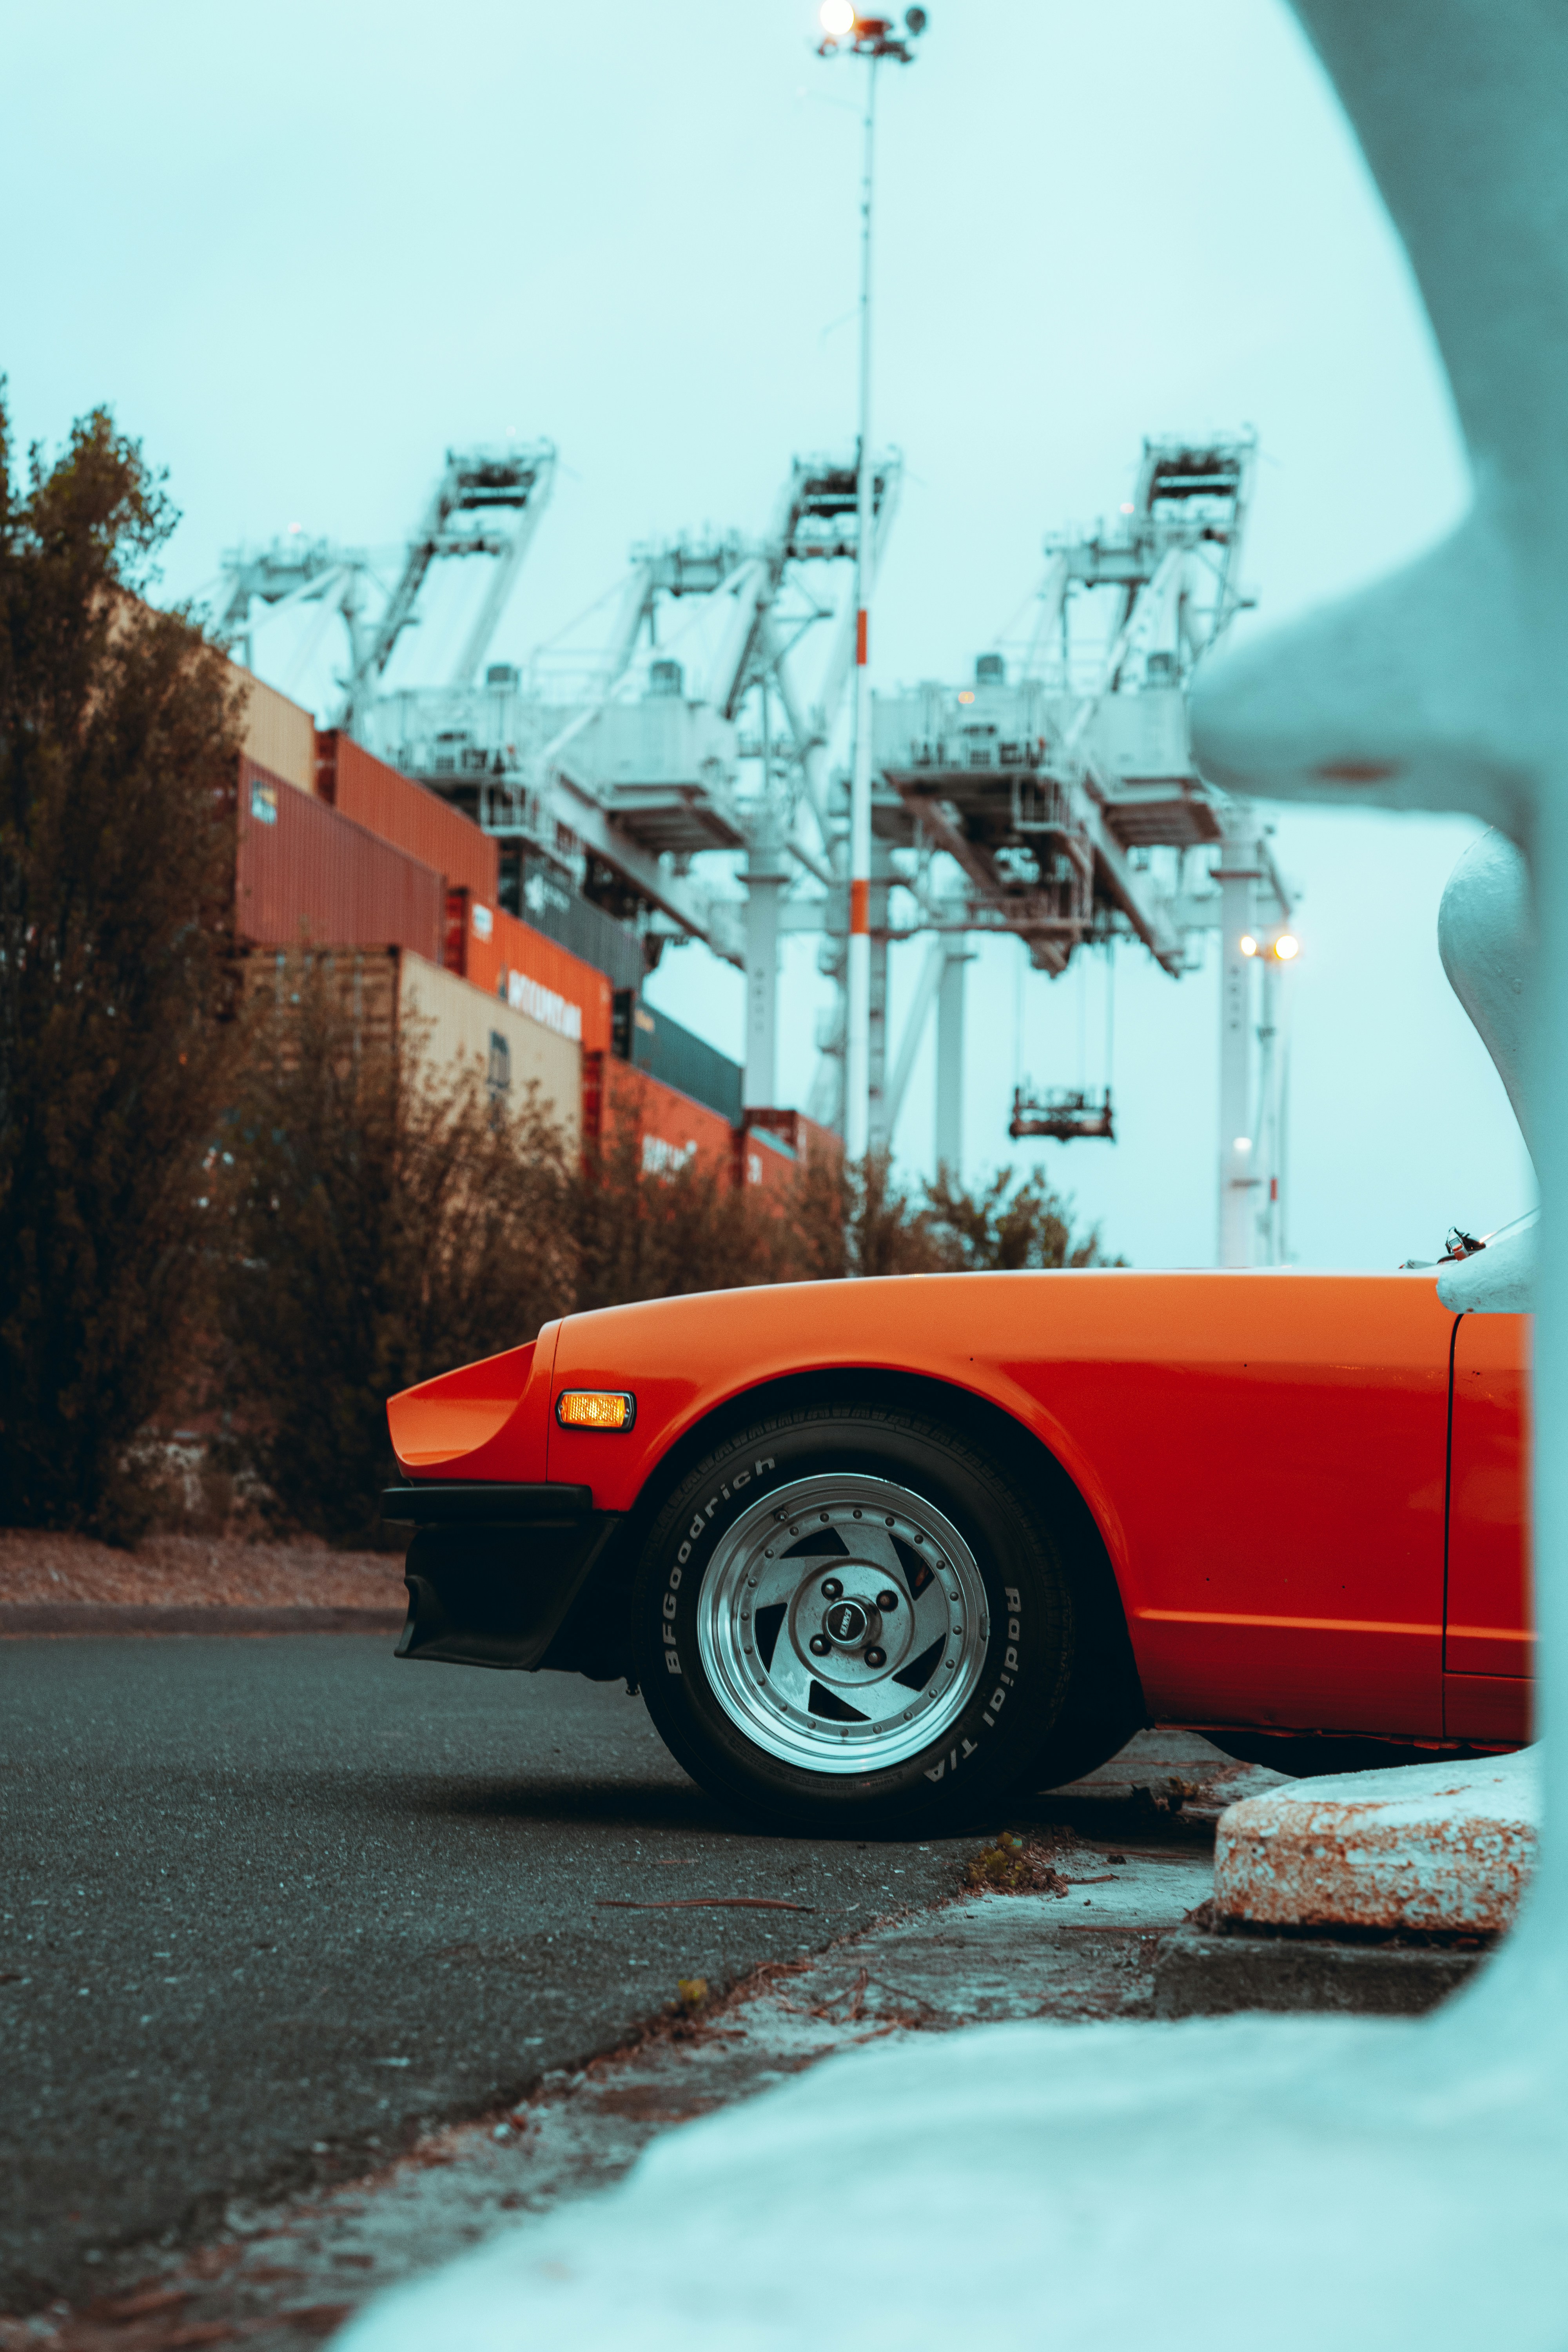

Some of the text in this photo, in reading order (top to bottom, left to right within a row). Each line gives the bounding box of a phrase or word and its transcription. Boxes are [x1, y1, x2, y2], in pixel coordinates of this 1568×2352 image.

[663, 1457, 775, 1673] BFGoodrich
[924, 1588, 1021, 1781] Radial T/A
